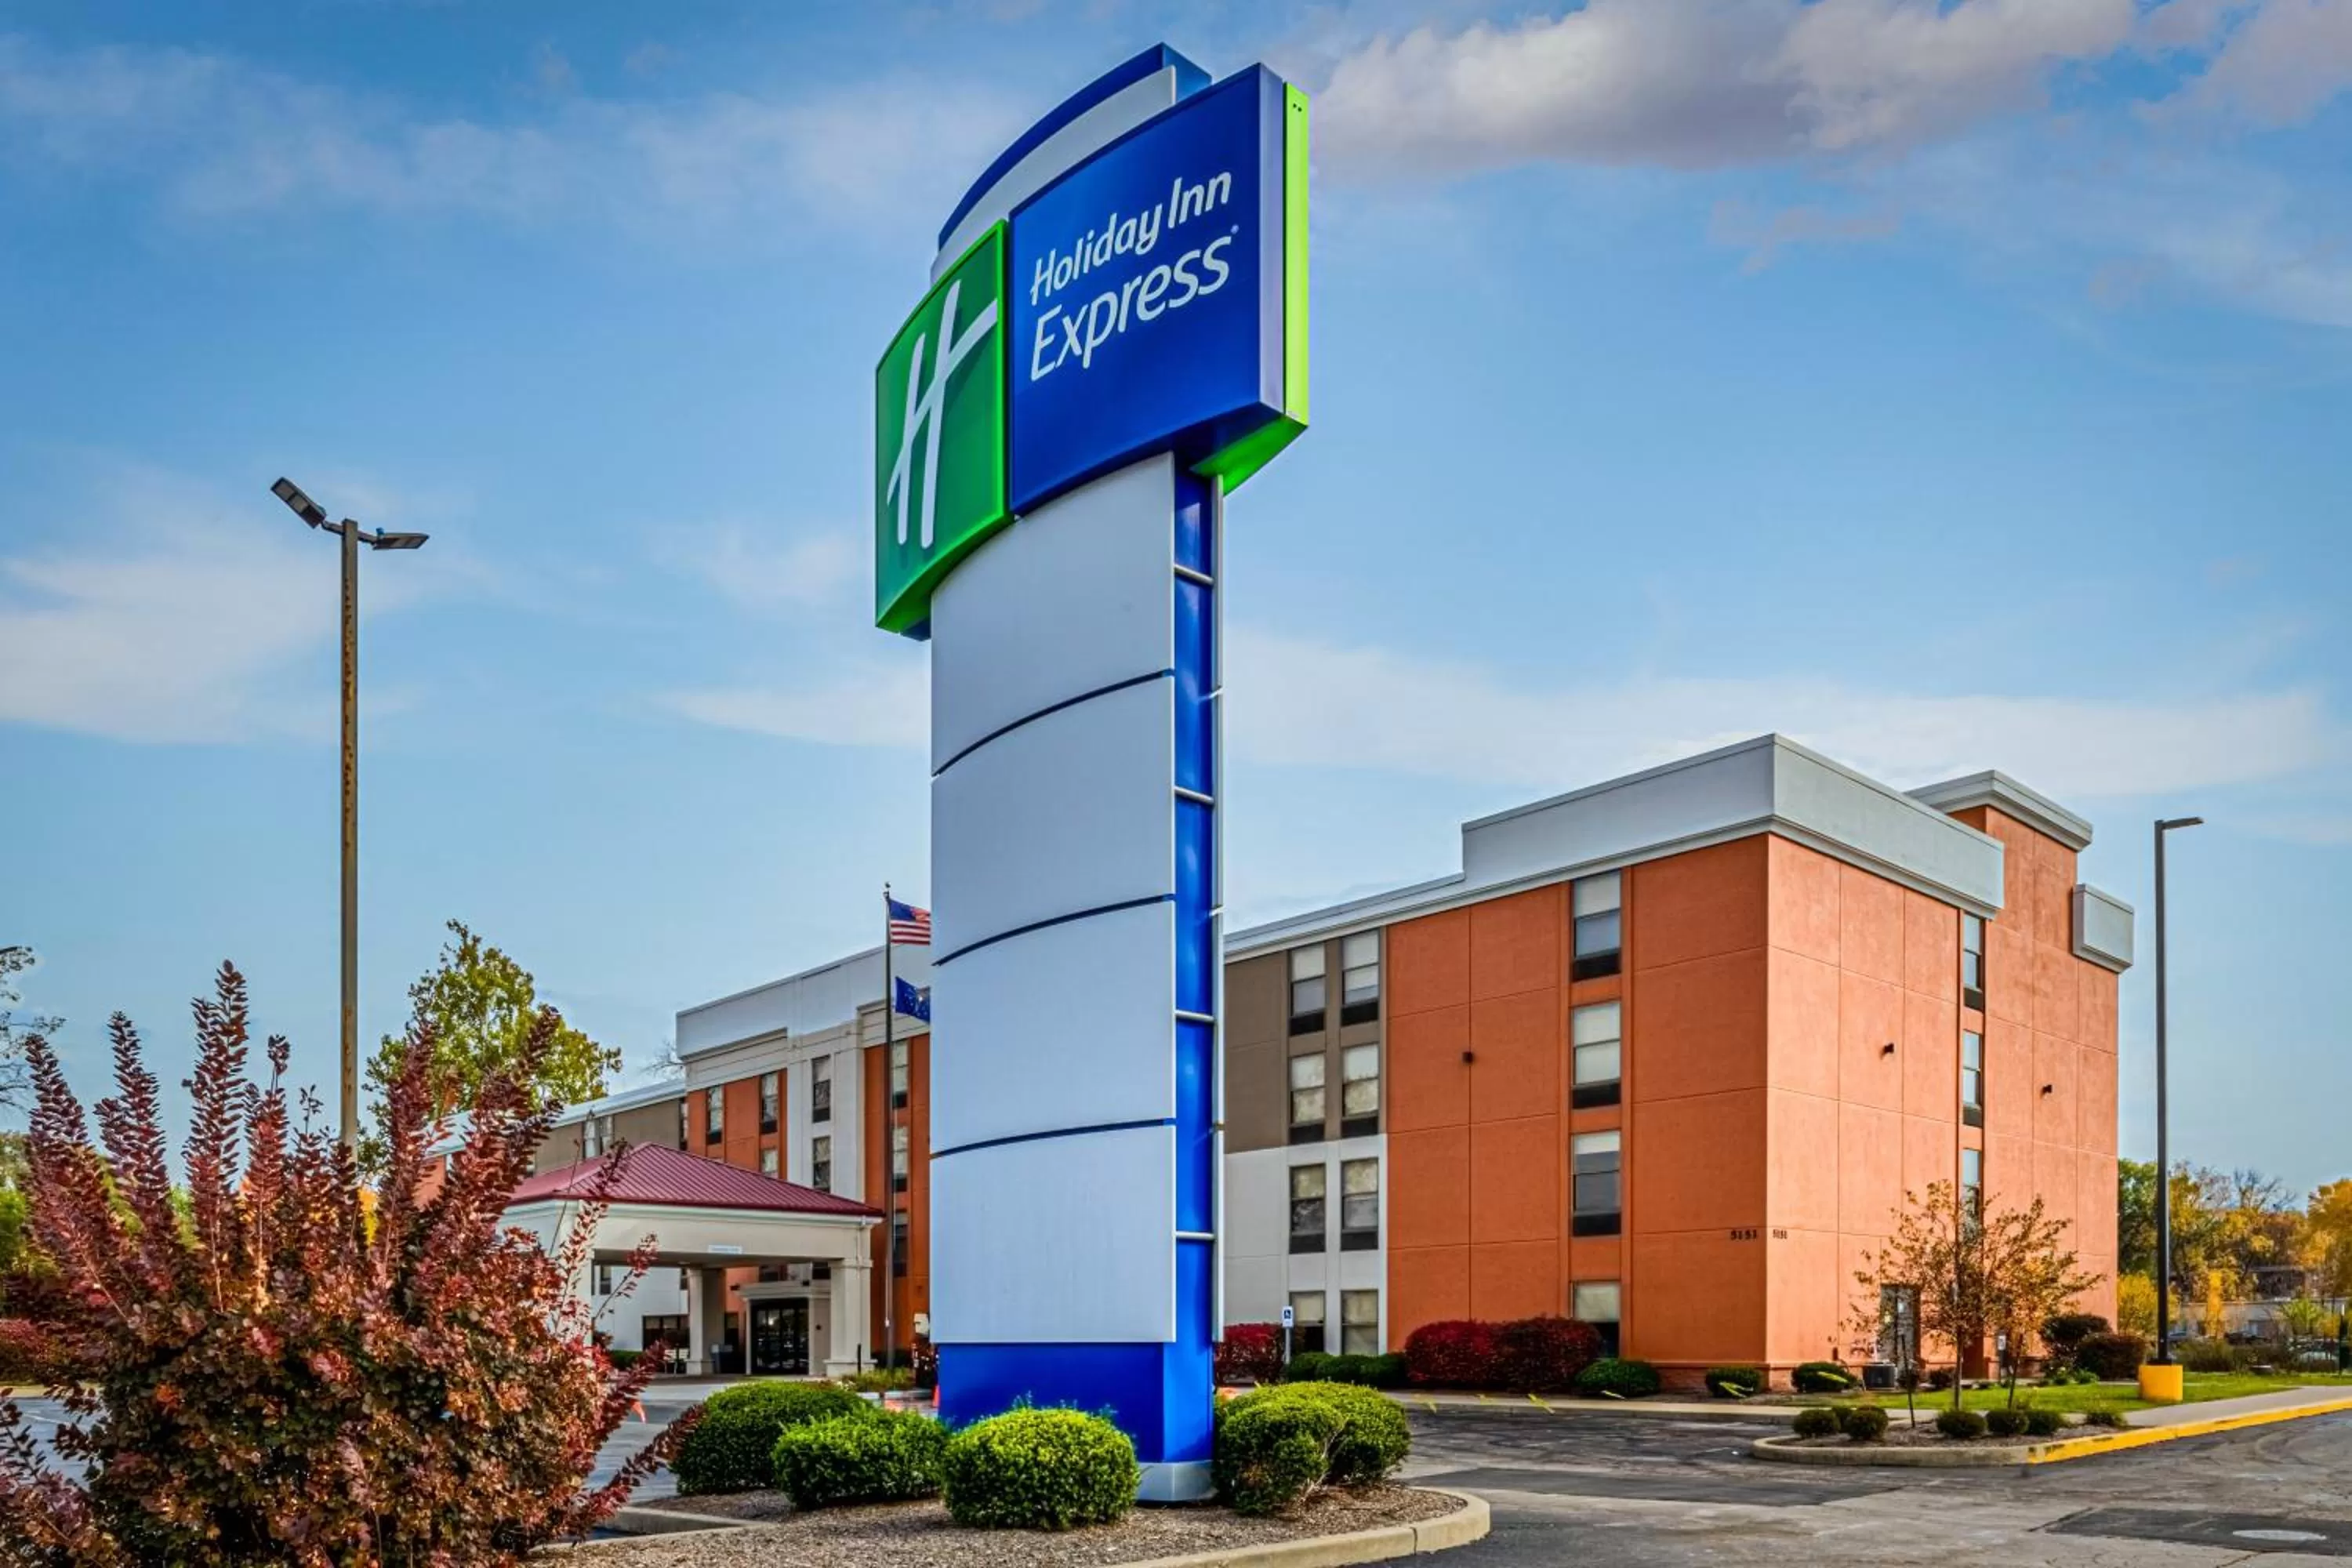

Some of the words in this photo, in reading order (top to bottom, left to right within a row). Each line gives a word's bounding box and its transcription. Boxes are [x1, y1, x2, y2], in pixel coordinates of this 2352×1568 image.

[1029, 203, 1163, 306] Holiday
[1167, 172, 1232, 229] Inn
[1031, 236, 1232, 382] Express
[887, 278, 998, 550] H
